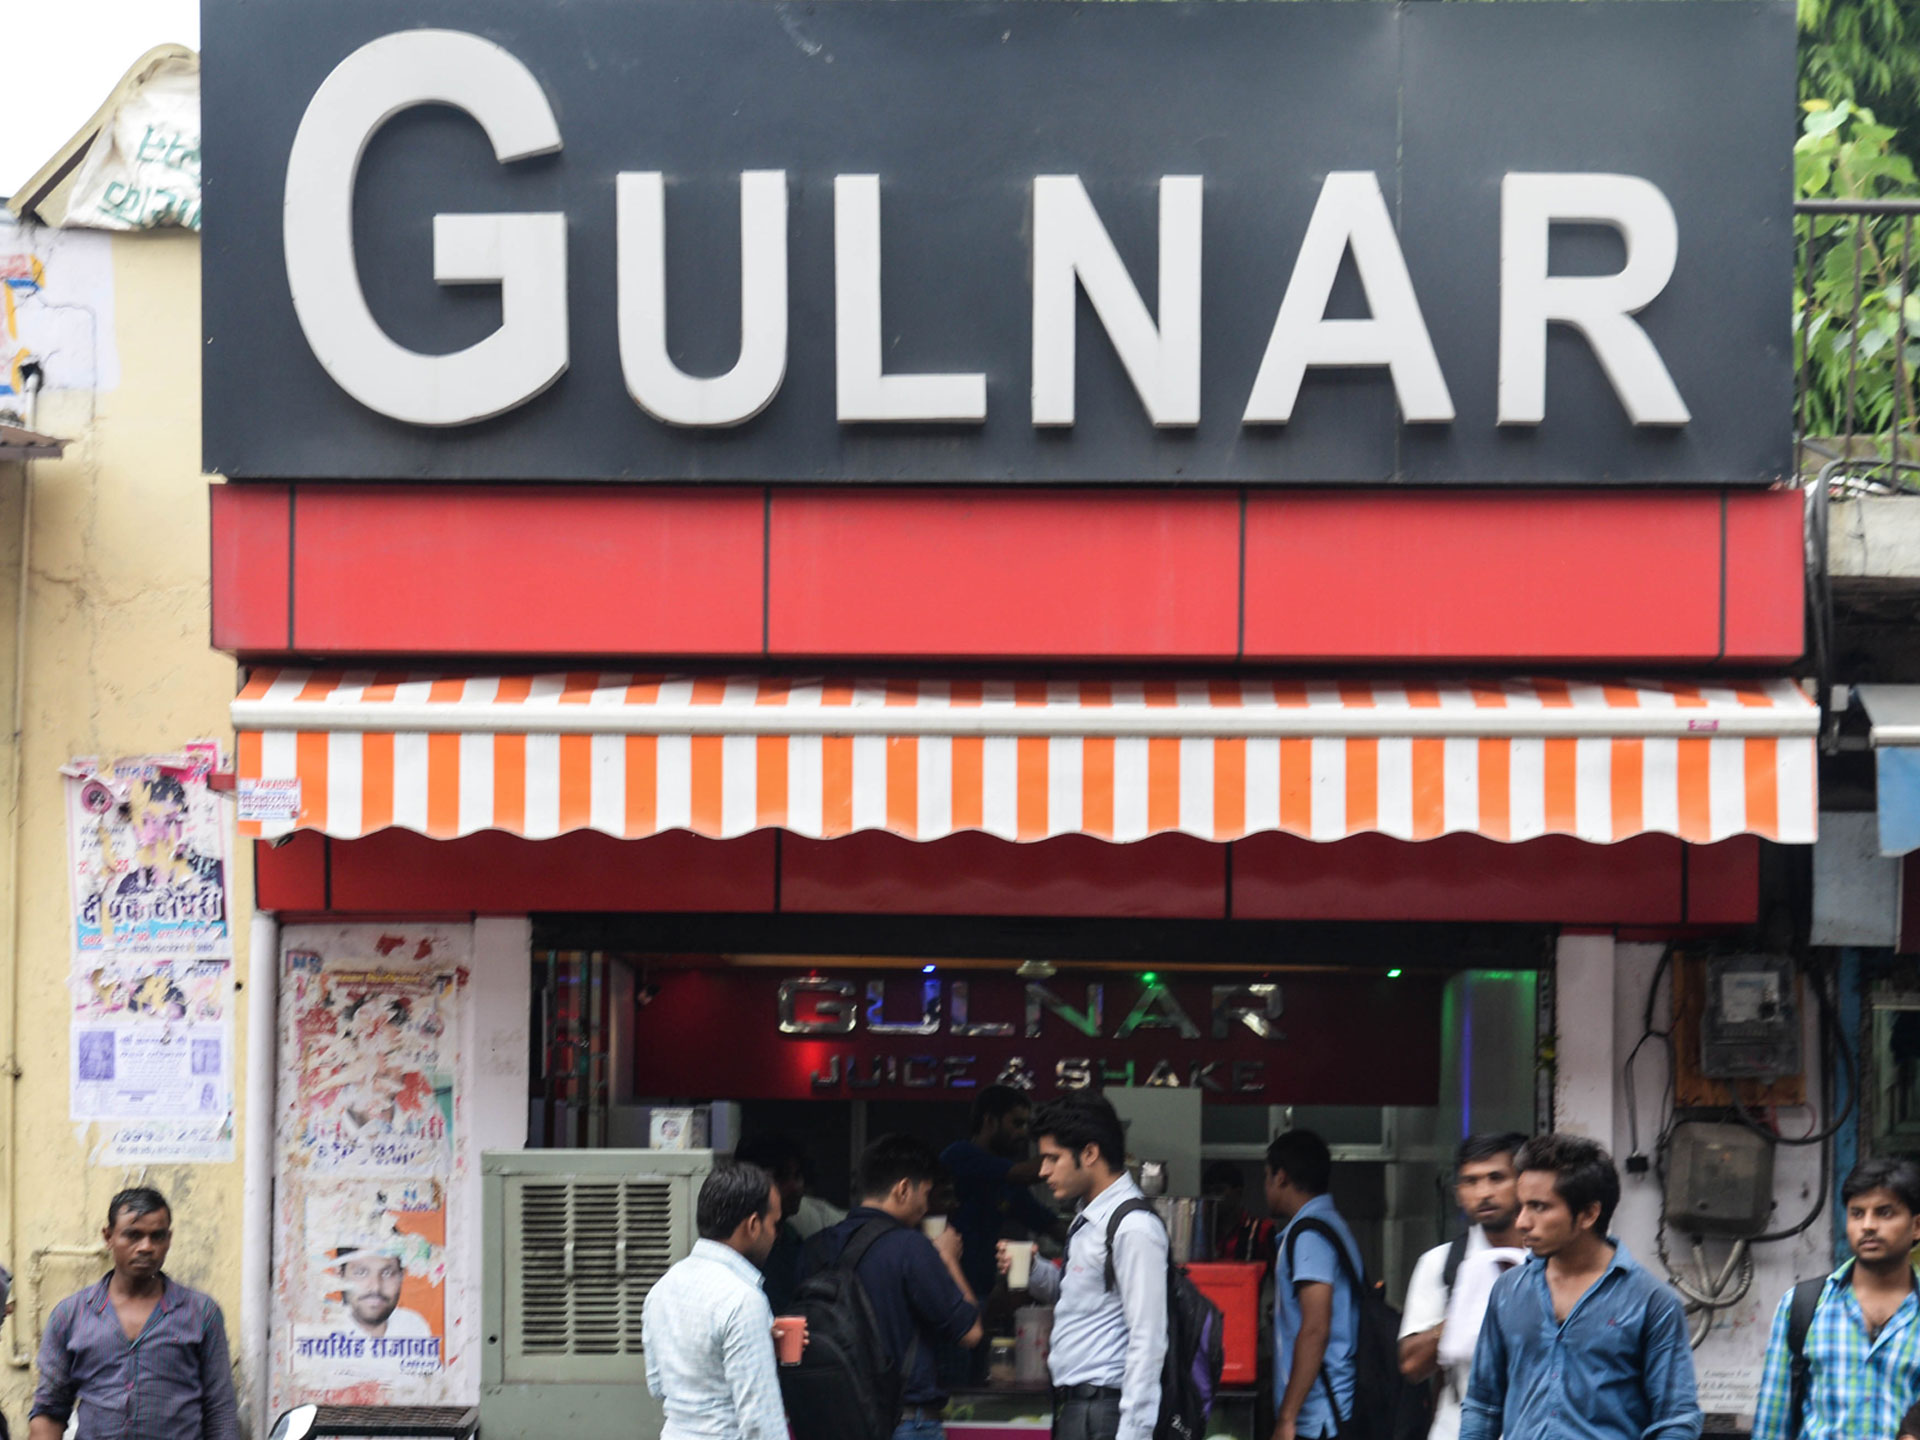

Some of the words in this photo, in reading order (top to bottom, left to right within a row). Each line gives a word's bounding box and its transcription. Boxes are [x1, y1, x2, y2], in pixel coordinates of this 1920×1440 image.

[283, 28, 1691, 428] GULNAR
[777, 976, 1287, 1039] GULNAR
[810, 1054, 976, 1090] JUICE
[998, 1055, 1036, 1090] &
[1055, 1058, 1265, 1092] SHAKE
